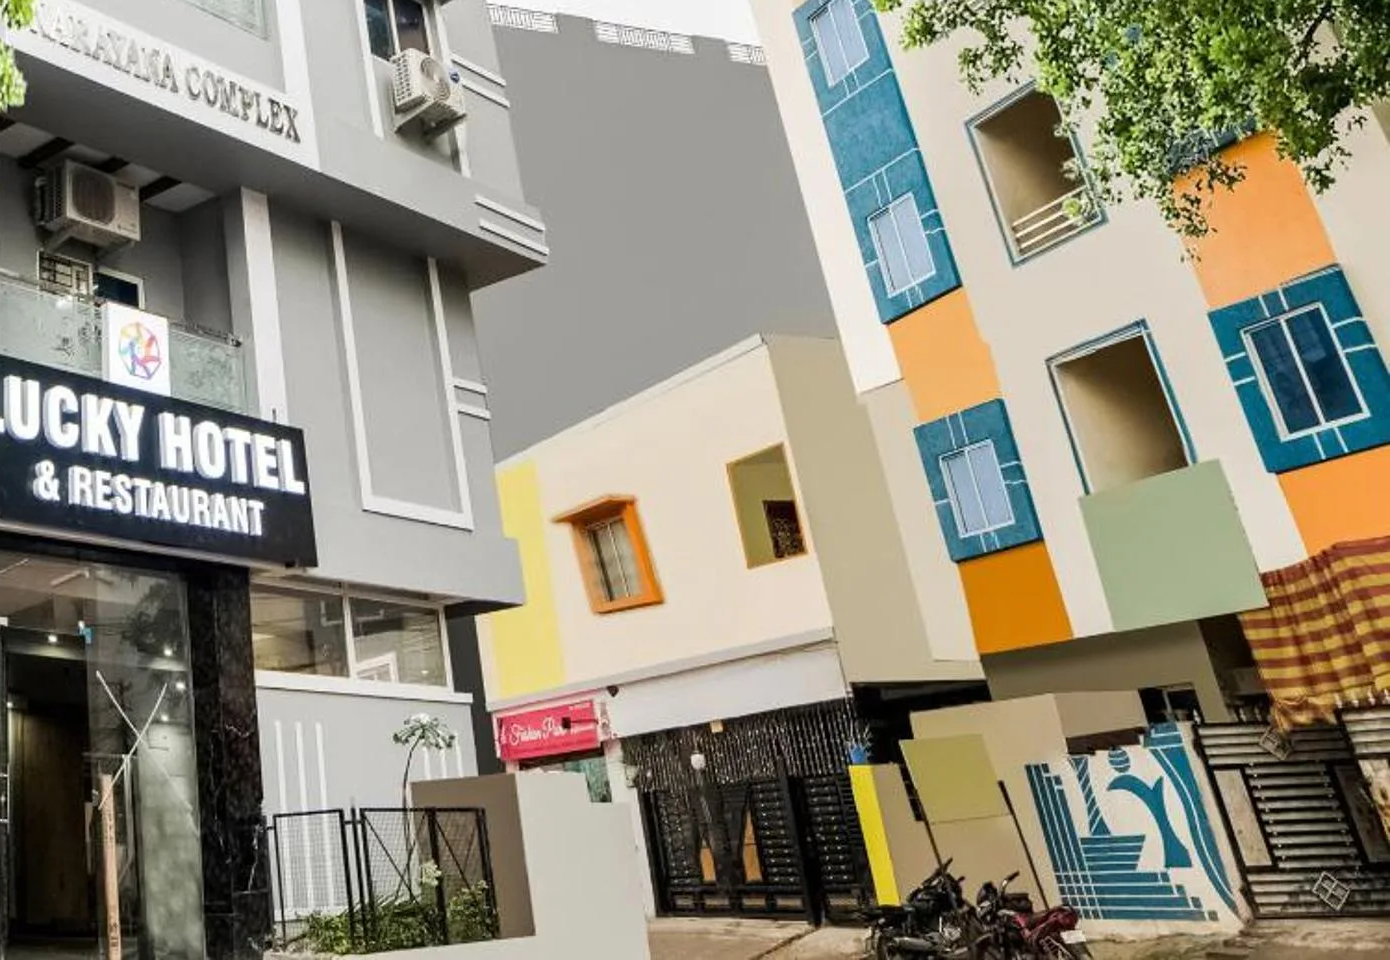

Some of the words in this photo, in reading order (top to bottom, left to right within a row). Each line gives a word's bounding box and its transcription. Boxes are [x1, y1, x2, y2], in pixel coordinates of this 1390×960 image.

[184, 66, 302, 144] COMPLEX
[157, 411, 306, 496] HOTEL
[32, 459, 61, 502] &
[67, 465, 264, 537] RESTAURANT
